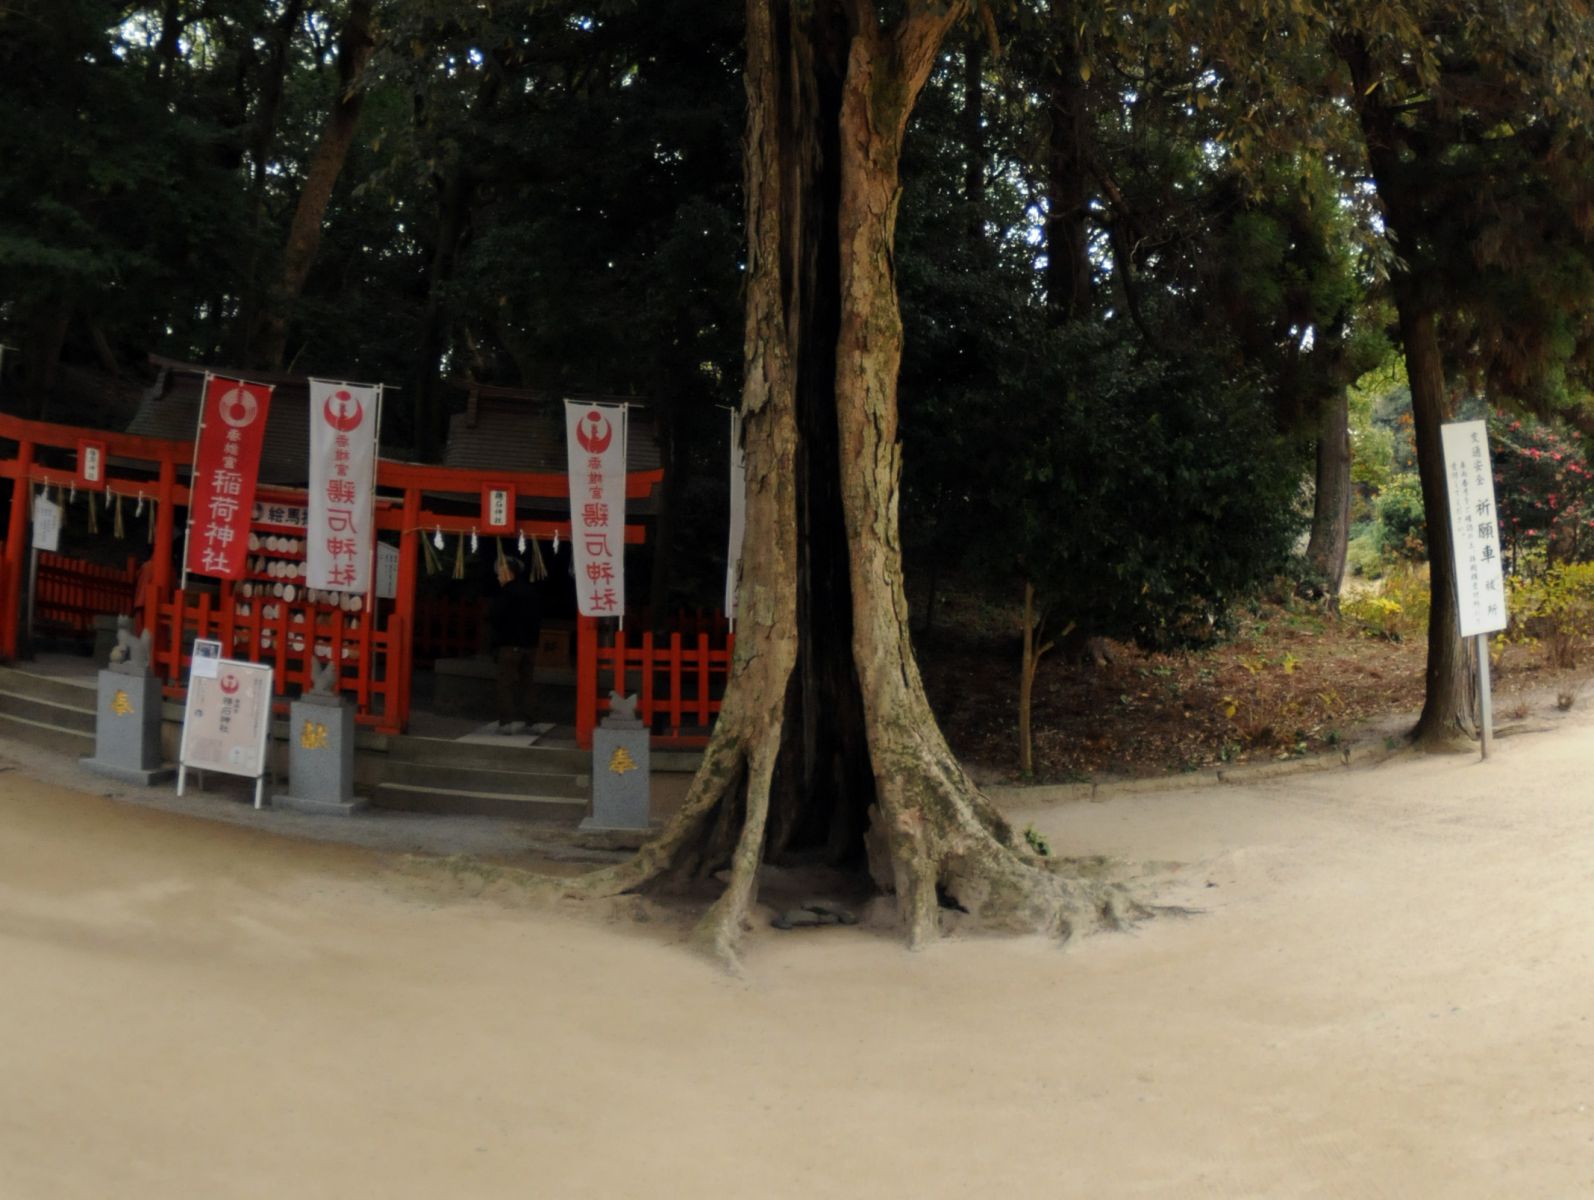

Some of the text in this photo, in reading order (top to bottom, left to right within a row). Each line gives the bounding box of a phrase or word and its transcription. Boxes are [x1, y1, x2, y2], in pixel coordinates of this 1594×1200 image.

[201, 469, 243, 574] 稲荷神社
[1475, 498, 1495, 563] 祈願車
[111, 688, 135, 716] 奉
[607, 744, 640, 777] 奉
